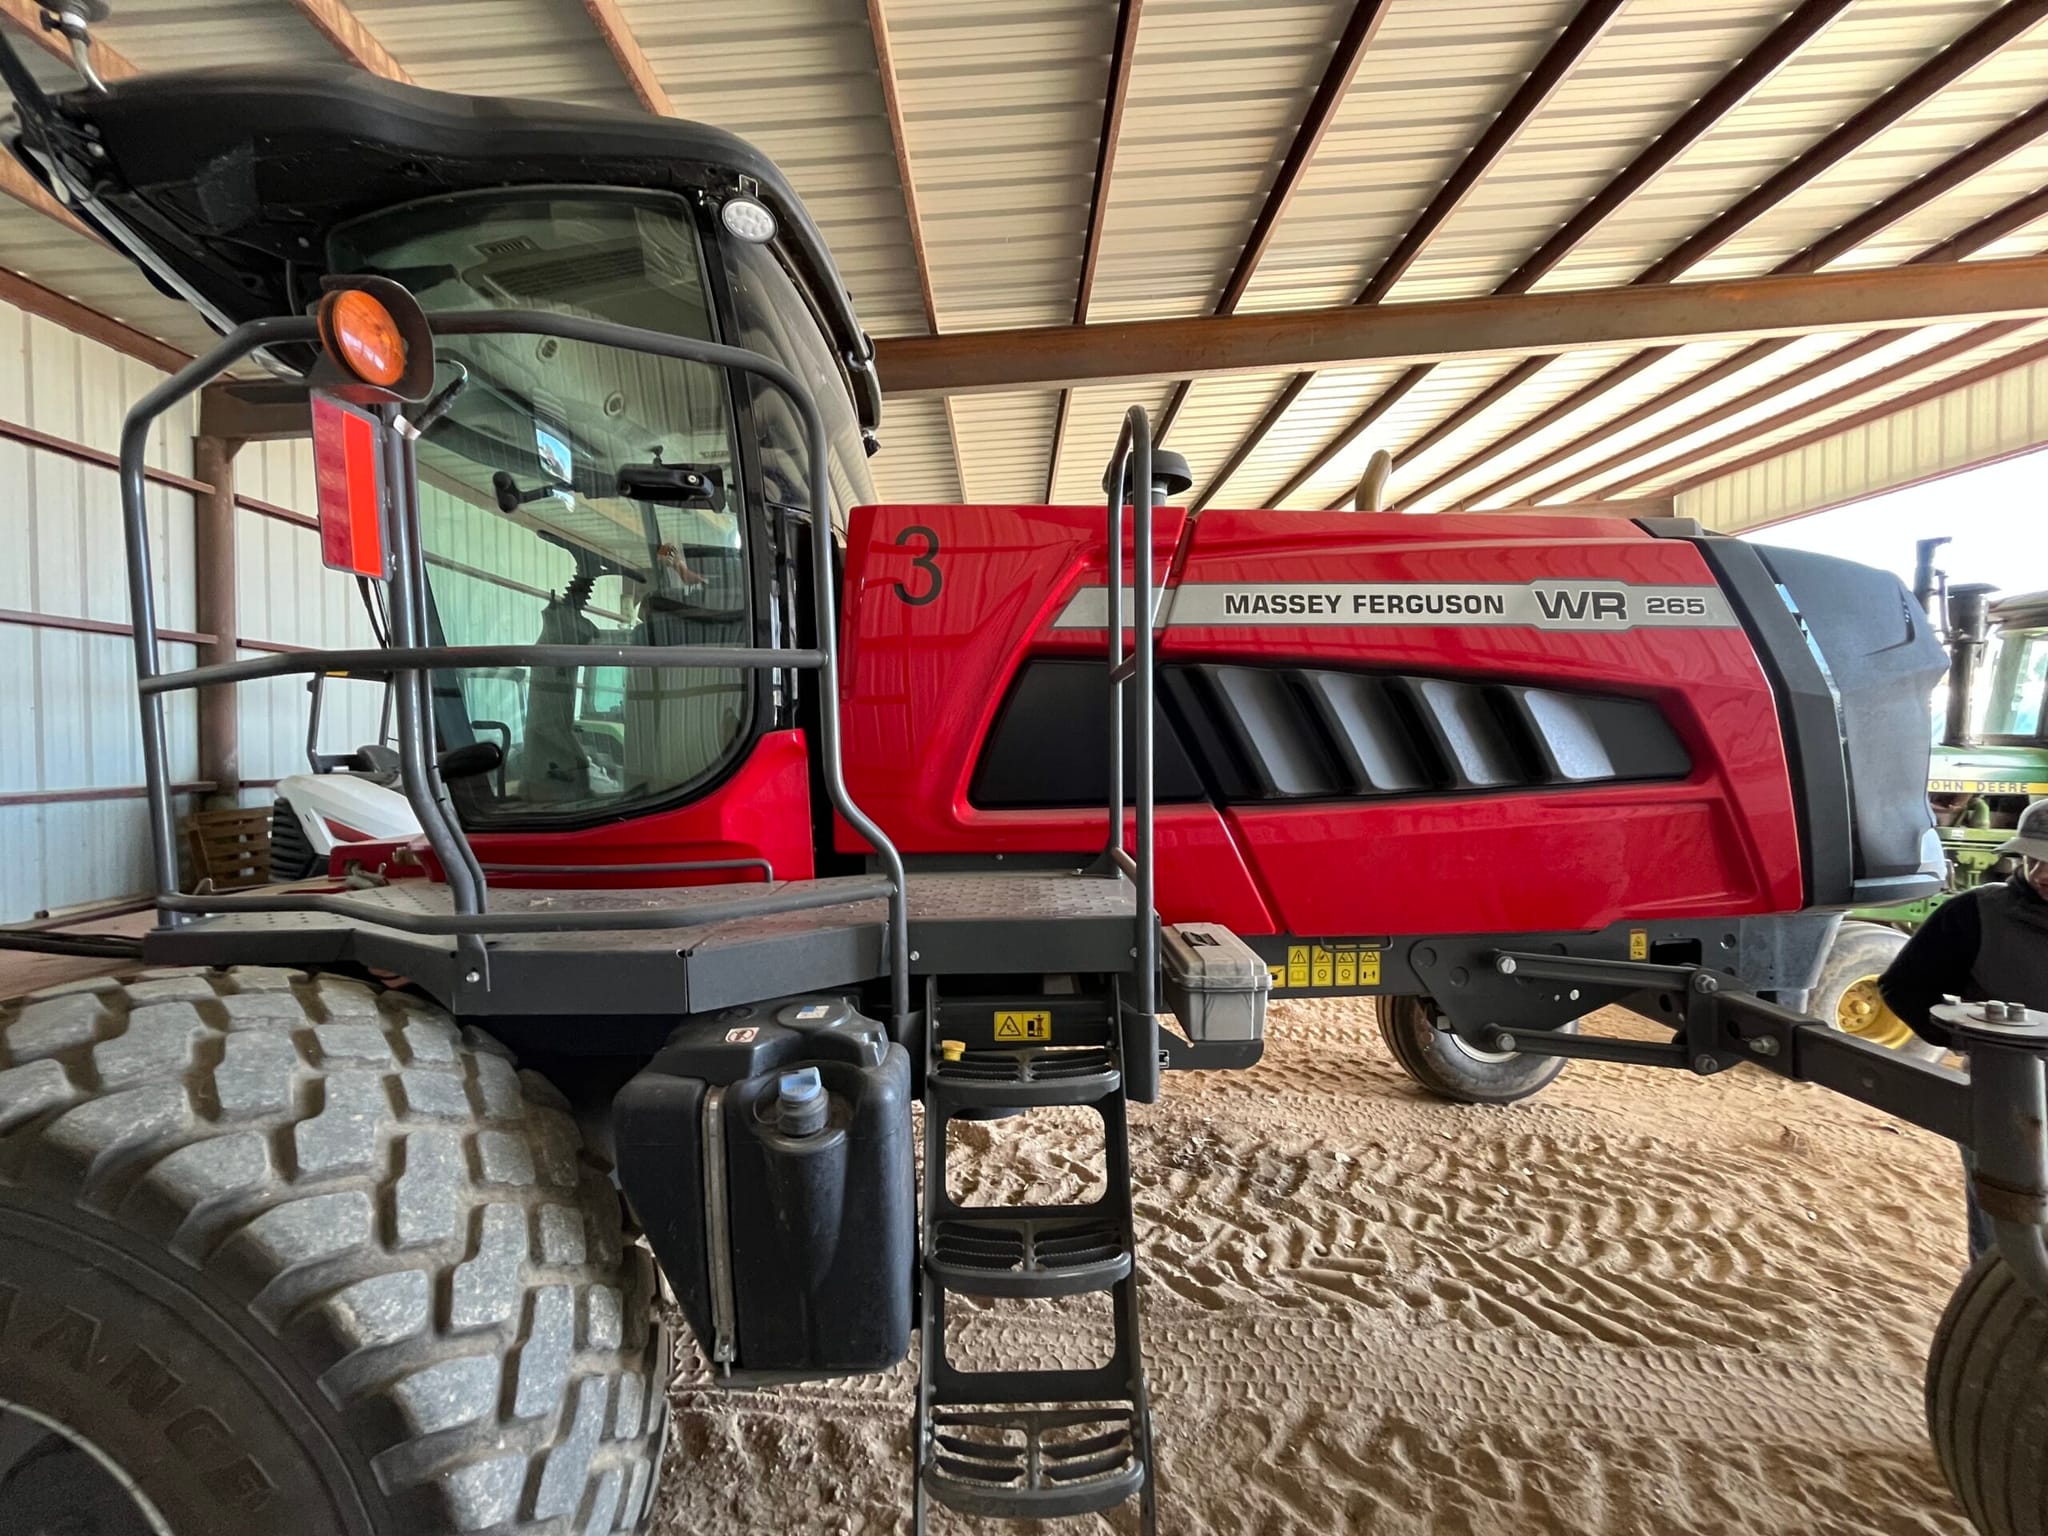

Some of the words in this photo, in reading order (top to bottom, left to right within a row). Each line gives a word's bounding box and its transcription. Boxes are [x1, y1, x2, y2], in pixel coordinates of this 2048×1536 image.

[894, 525, 943, 606] 3
[1224, 594, 1343, 615] MASSEY
[1352, 594, 1505, 615] FERGUSON
[1534, 590, 1628, 620] WR
[1647, 598, 1706, 615] 265
[1930, 781, 1964, 792] OHN
[1976, 783, 2028, 793] DEERE
